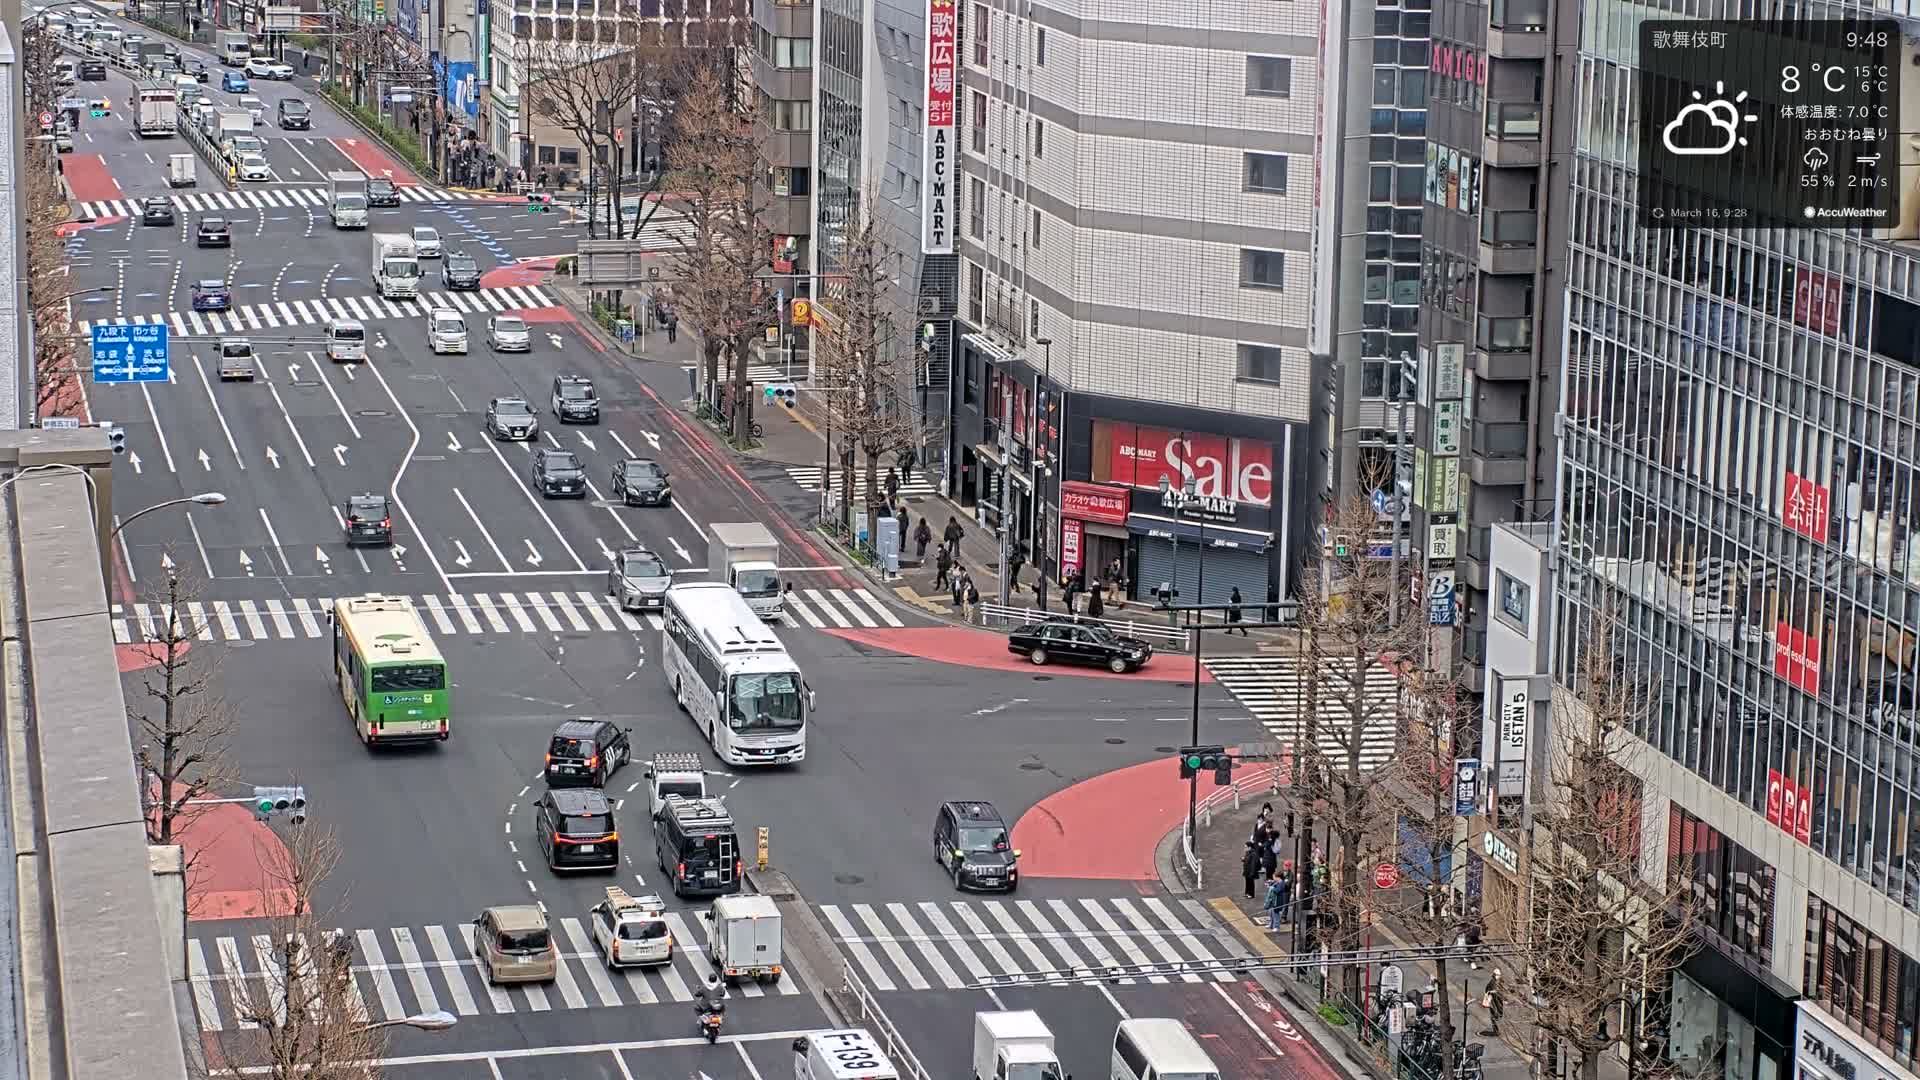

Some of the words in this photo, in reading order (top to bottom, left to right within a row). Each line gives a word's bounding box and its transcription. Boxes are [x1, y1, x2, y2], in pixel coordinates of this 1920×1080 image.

[931, 12, 953, 94] 歌広場
[1431, 44, 1486, 86] AMIGO
[929, 100, 953, 111] 受付
[930, 112, 952, 122] 5F
[99, 326, 127, 336] 九段下
[1165, 438, 1272, 504] Sale
[1789, 484, 1824, 532] 会計
[1433, 528, 1446, 554] 買取
[1430, 612, 1450, 622] BIZ
[1513, 692, 1526, 703] 5
[1503, 704, 1511, 720] CITY
[1503, 722, 1511, 740] PARK
[1511, 707, 1525, 747] ISETAN
[1769, 781, 1809, 828] CPA
[824, 1033, 880, 1069] F-139
